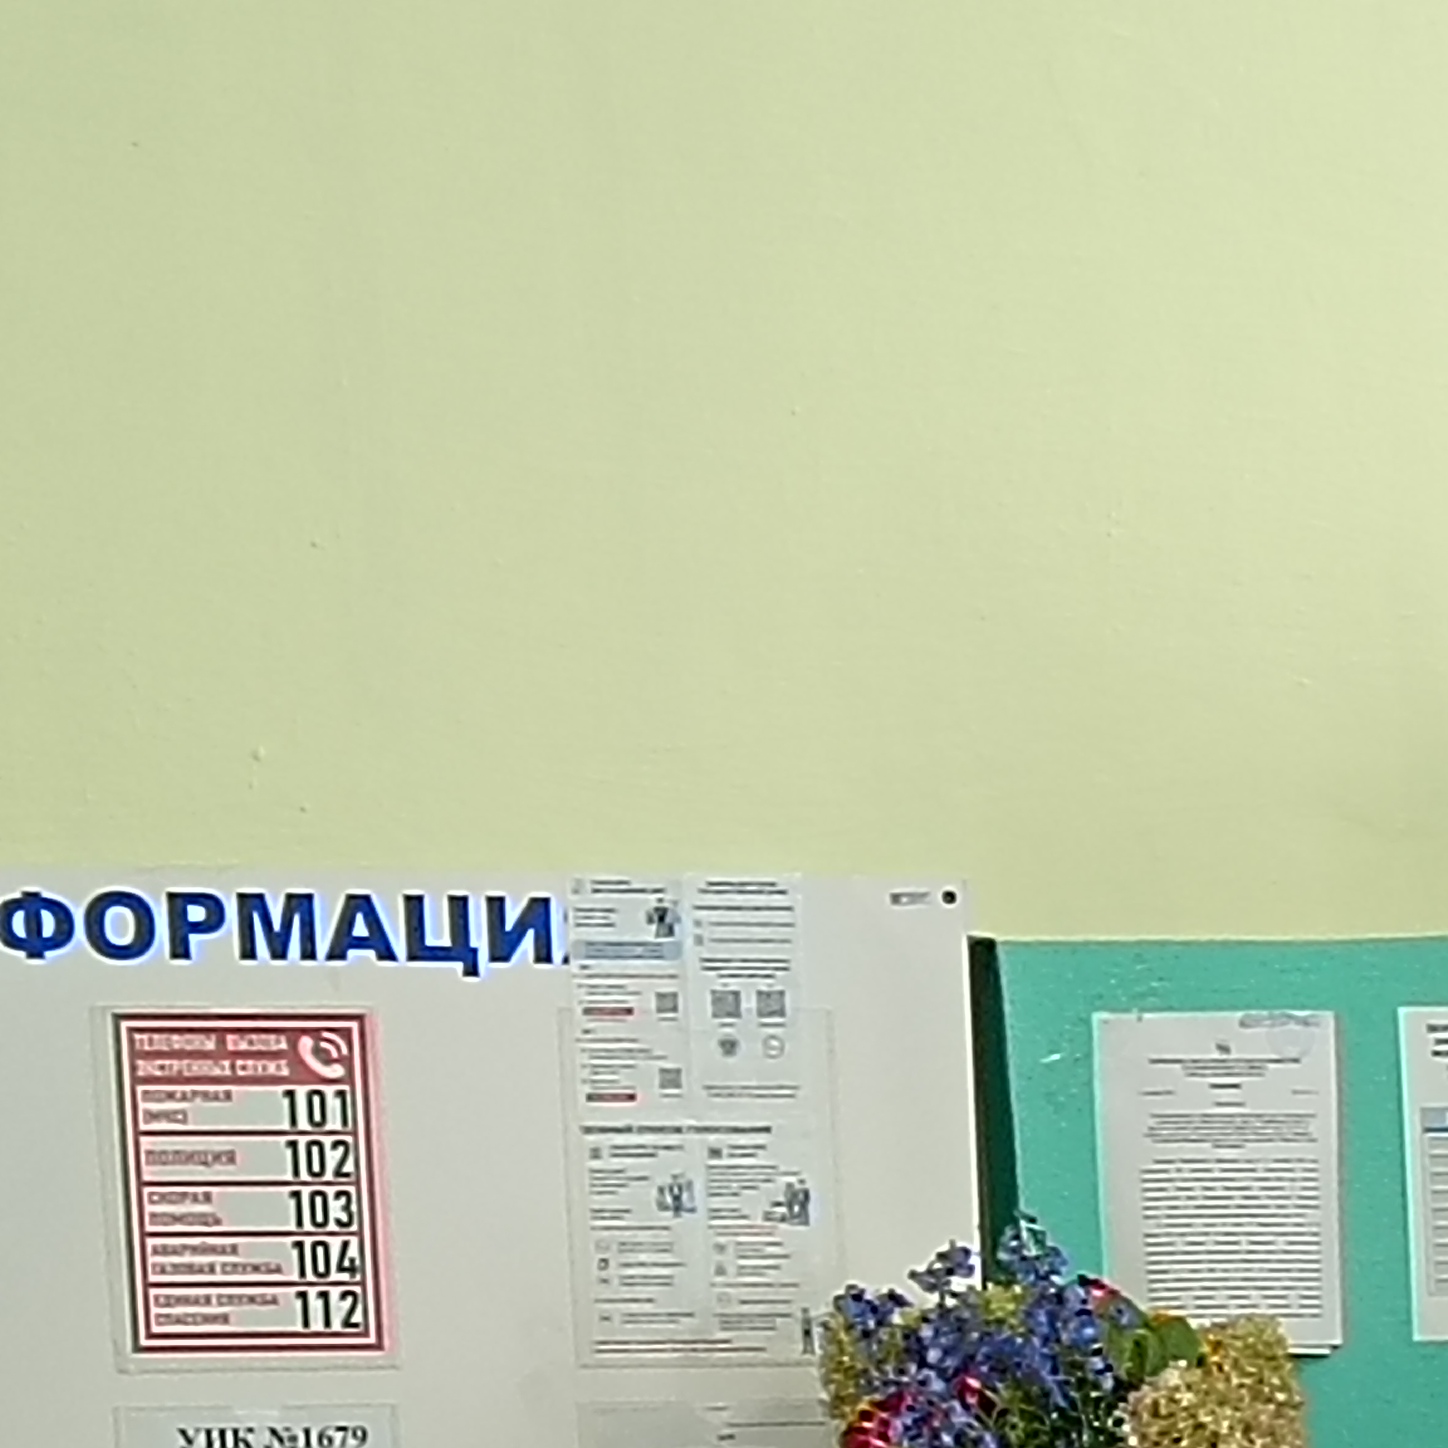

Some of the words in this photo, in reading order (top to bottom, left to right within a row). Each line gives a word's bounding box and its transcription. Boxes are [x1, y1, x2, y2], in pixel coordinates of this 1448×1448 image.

[0, 889, 569, 978] ФОРМАЦИ
[282, 1089, 350, 1128] 101
[285, 1139, 352, 1179] 102
[288, 1190, 355, 1229] 103
[291, 1240, 358, 1280] 104
[295, 1289, 361, 1330] 112
